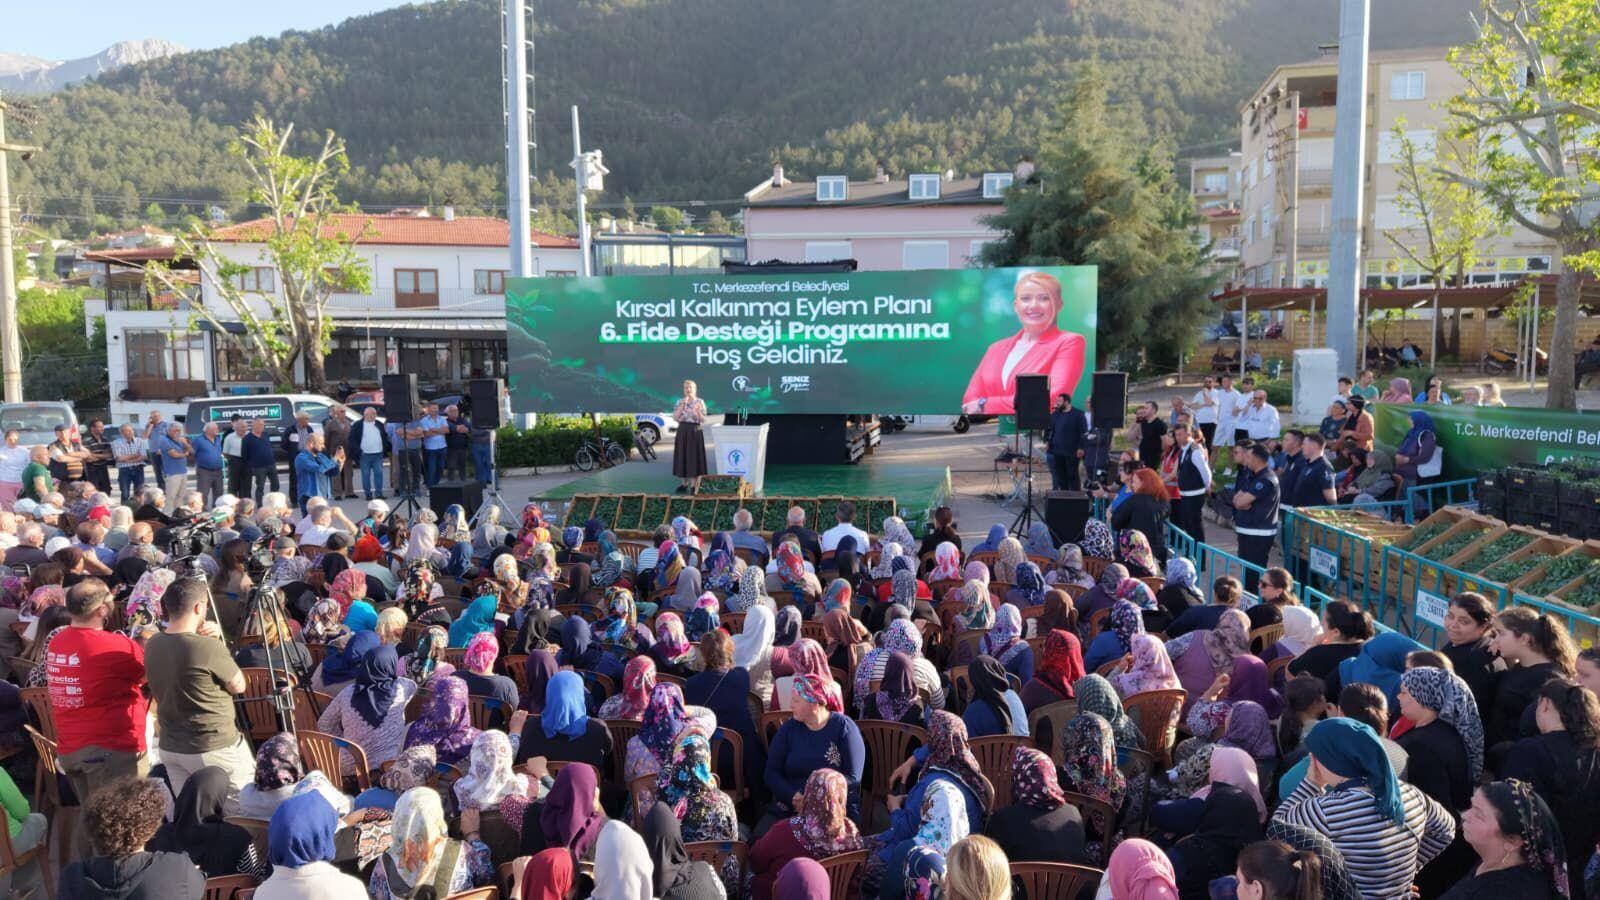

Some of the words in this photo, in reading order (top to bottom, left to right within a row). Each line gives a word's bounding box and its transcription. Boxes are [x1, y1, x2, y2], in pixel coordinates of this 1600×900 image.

[692, 283, 712, 294] T.C.
[715, 281, 790, 293] Merkezefendi
[792, 280, 850, 294] Belediyesi
[616, 299, 676, 318] Kırsal
[681, 297, 790, 317] Kalkınma
[796, 297, 868, 322] Eylem
[874, 295, 932, 315] Planı
[600, 322, 622, 341] 6.
[627, 321, 680, 341] Fide
[686, 320, 782, 346] Desteği
[788, 321, 949, 345] Programına
[696, 346, 742, 370] Hoş
[747, 344, 848, 365] Geldiniz.
[270, 408, 279, 416] TV
[1455, 423, 1477, 436] T.C.
[1480, 424, 1573, 443] Merkezefendi
